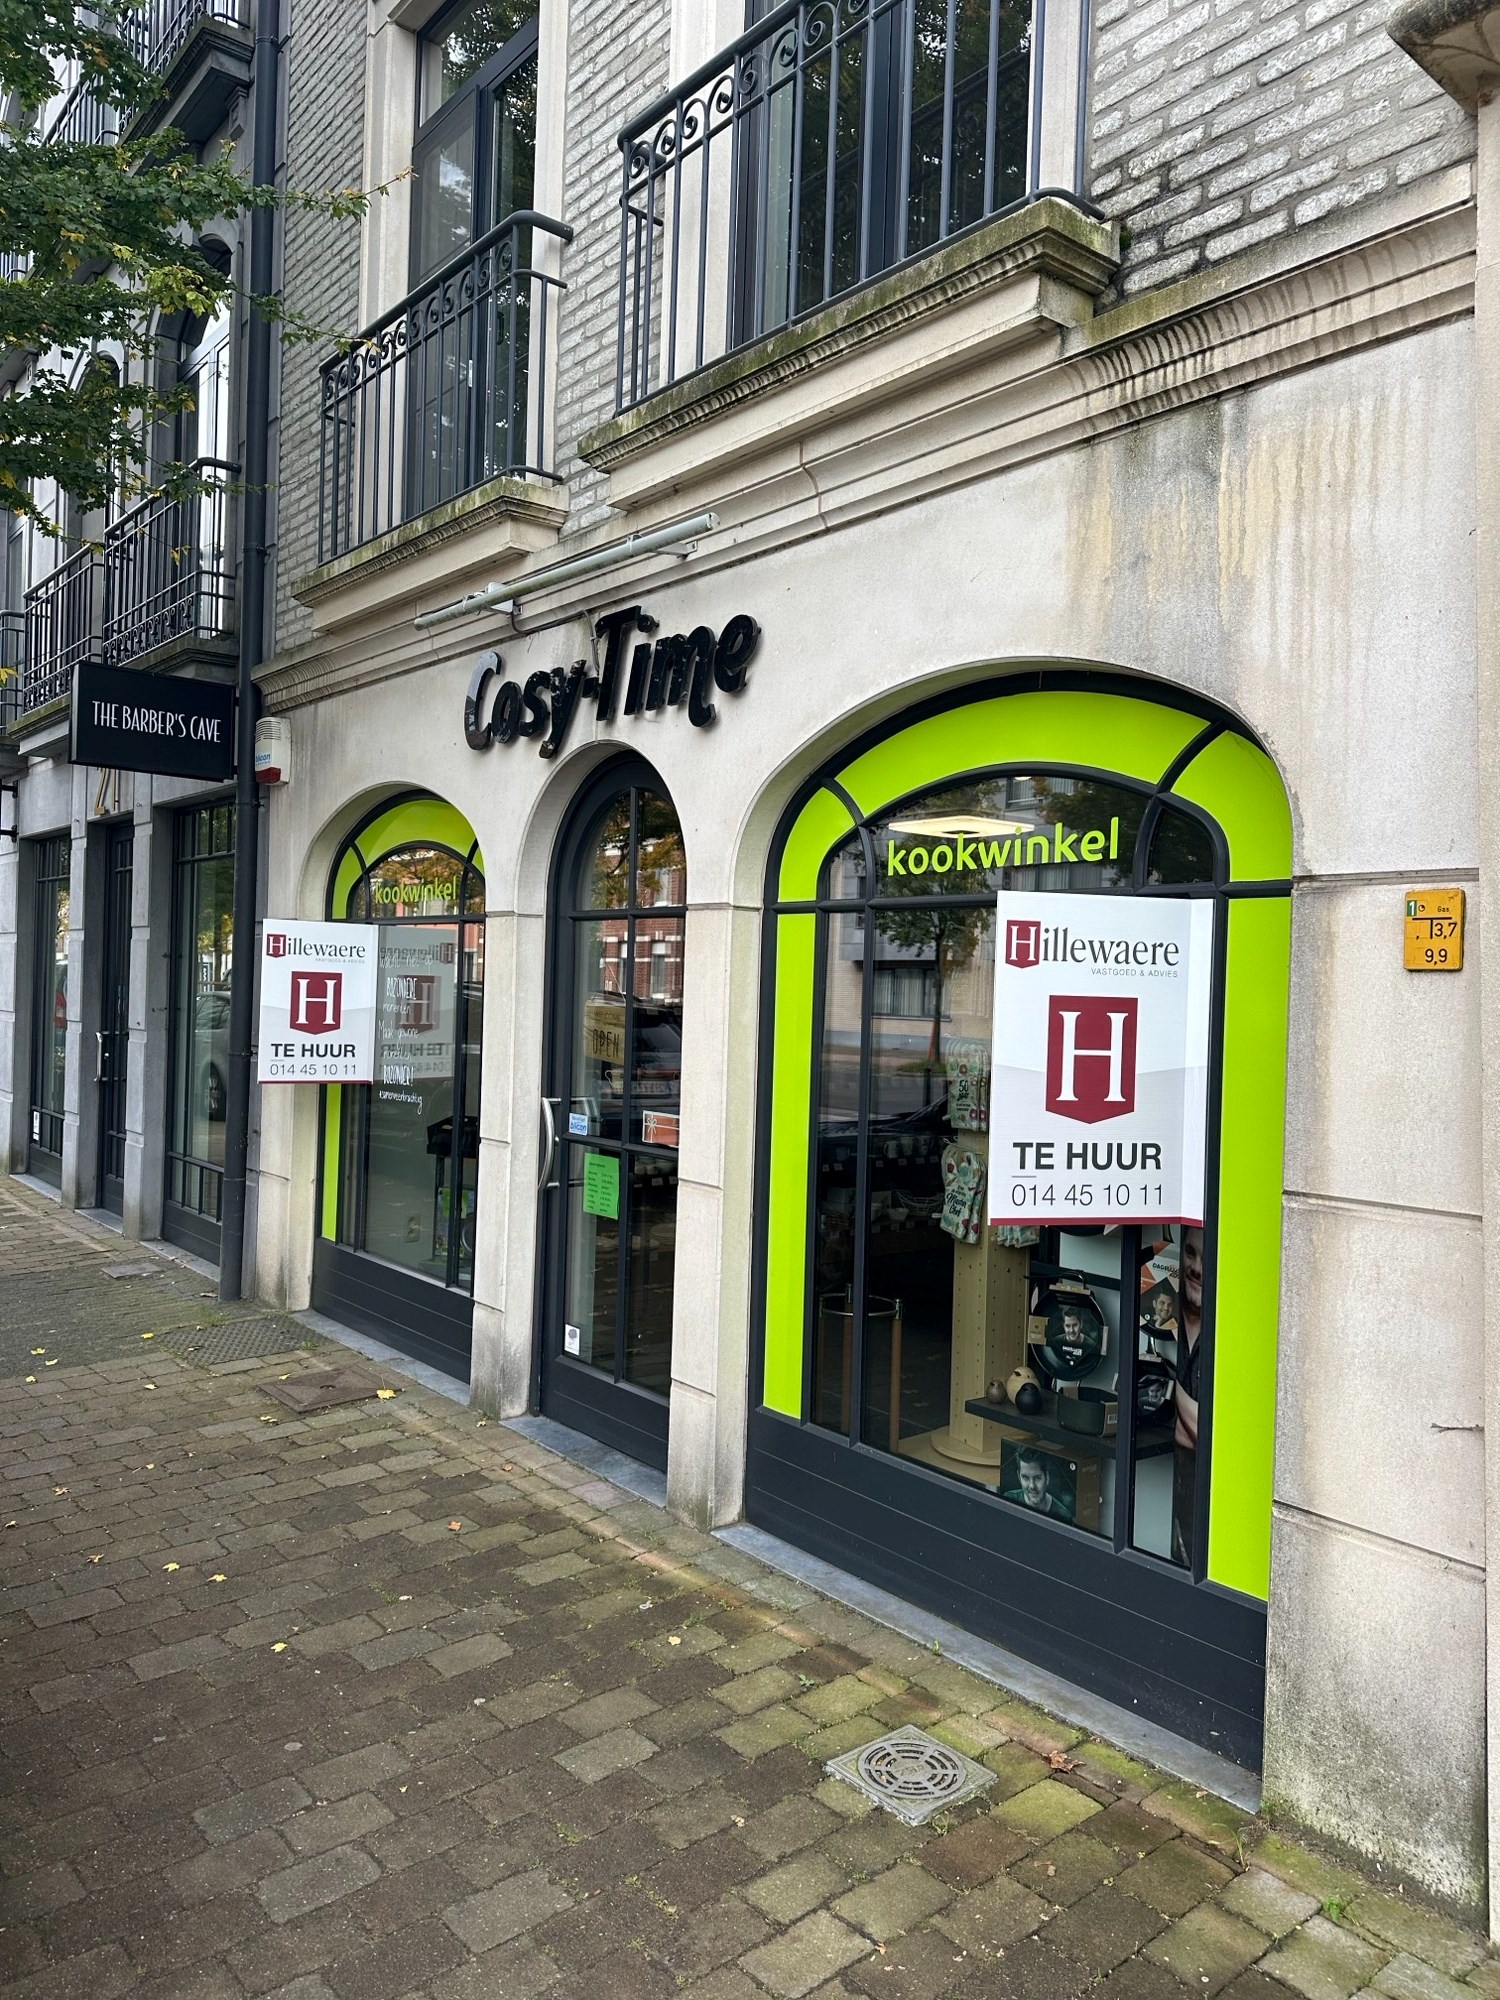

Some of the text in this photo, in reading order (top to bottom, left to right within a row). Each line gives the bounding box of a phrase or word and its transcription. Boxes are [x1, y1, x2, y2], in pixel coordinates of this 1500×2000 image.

[464, 605, 762, 759] Cosy-Time
[92, 701, 221, 743] THE BARBER'S CAVE
[887, 816, 1120, 876] kookwinkel
[375, 875, 457, 904] kookwinkel
[1409, 901, 1416, 916] 1
[1437, 905, 1450, 913] Gas
[1434, 922, 1458, 940] 3,7
[268, 936, 366, 958] Hillewaere
[1009, 925, 1180, 967] Hillewaere
[1425, 948, 1448, 966] 9,9
[1091, 968, 1179, 978] VASTGOED & ADVIES
[295, 978, 338, 1025] H
[270, 1043, 356, 1058] TE HUUR
[592, 1028, 620, 1060] OPEN
[1055, 1010, 1129, 1102] H
[270, 1063, 356, 1076] 014 45 10 11
[1012, 1142, 1162, 1171] TE HUUR
[1011, 1183, 1162, 1207] 014 45 10 11
